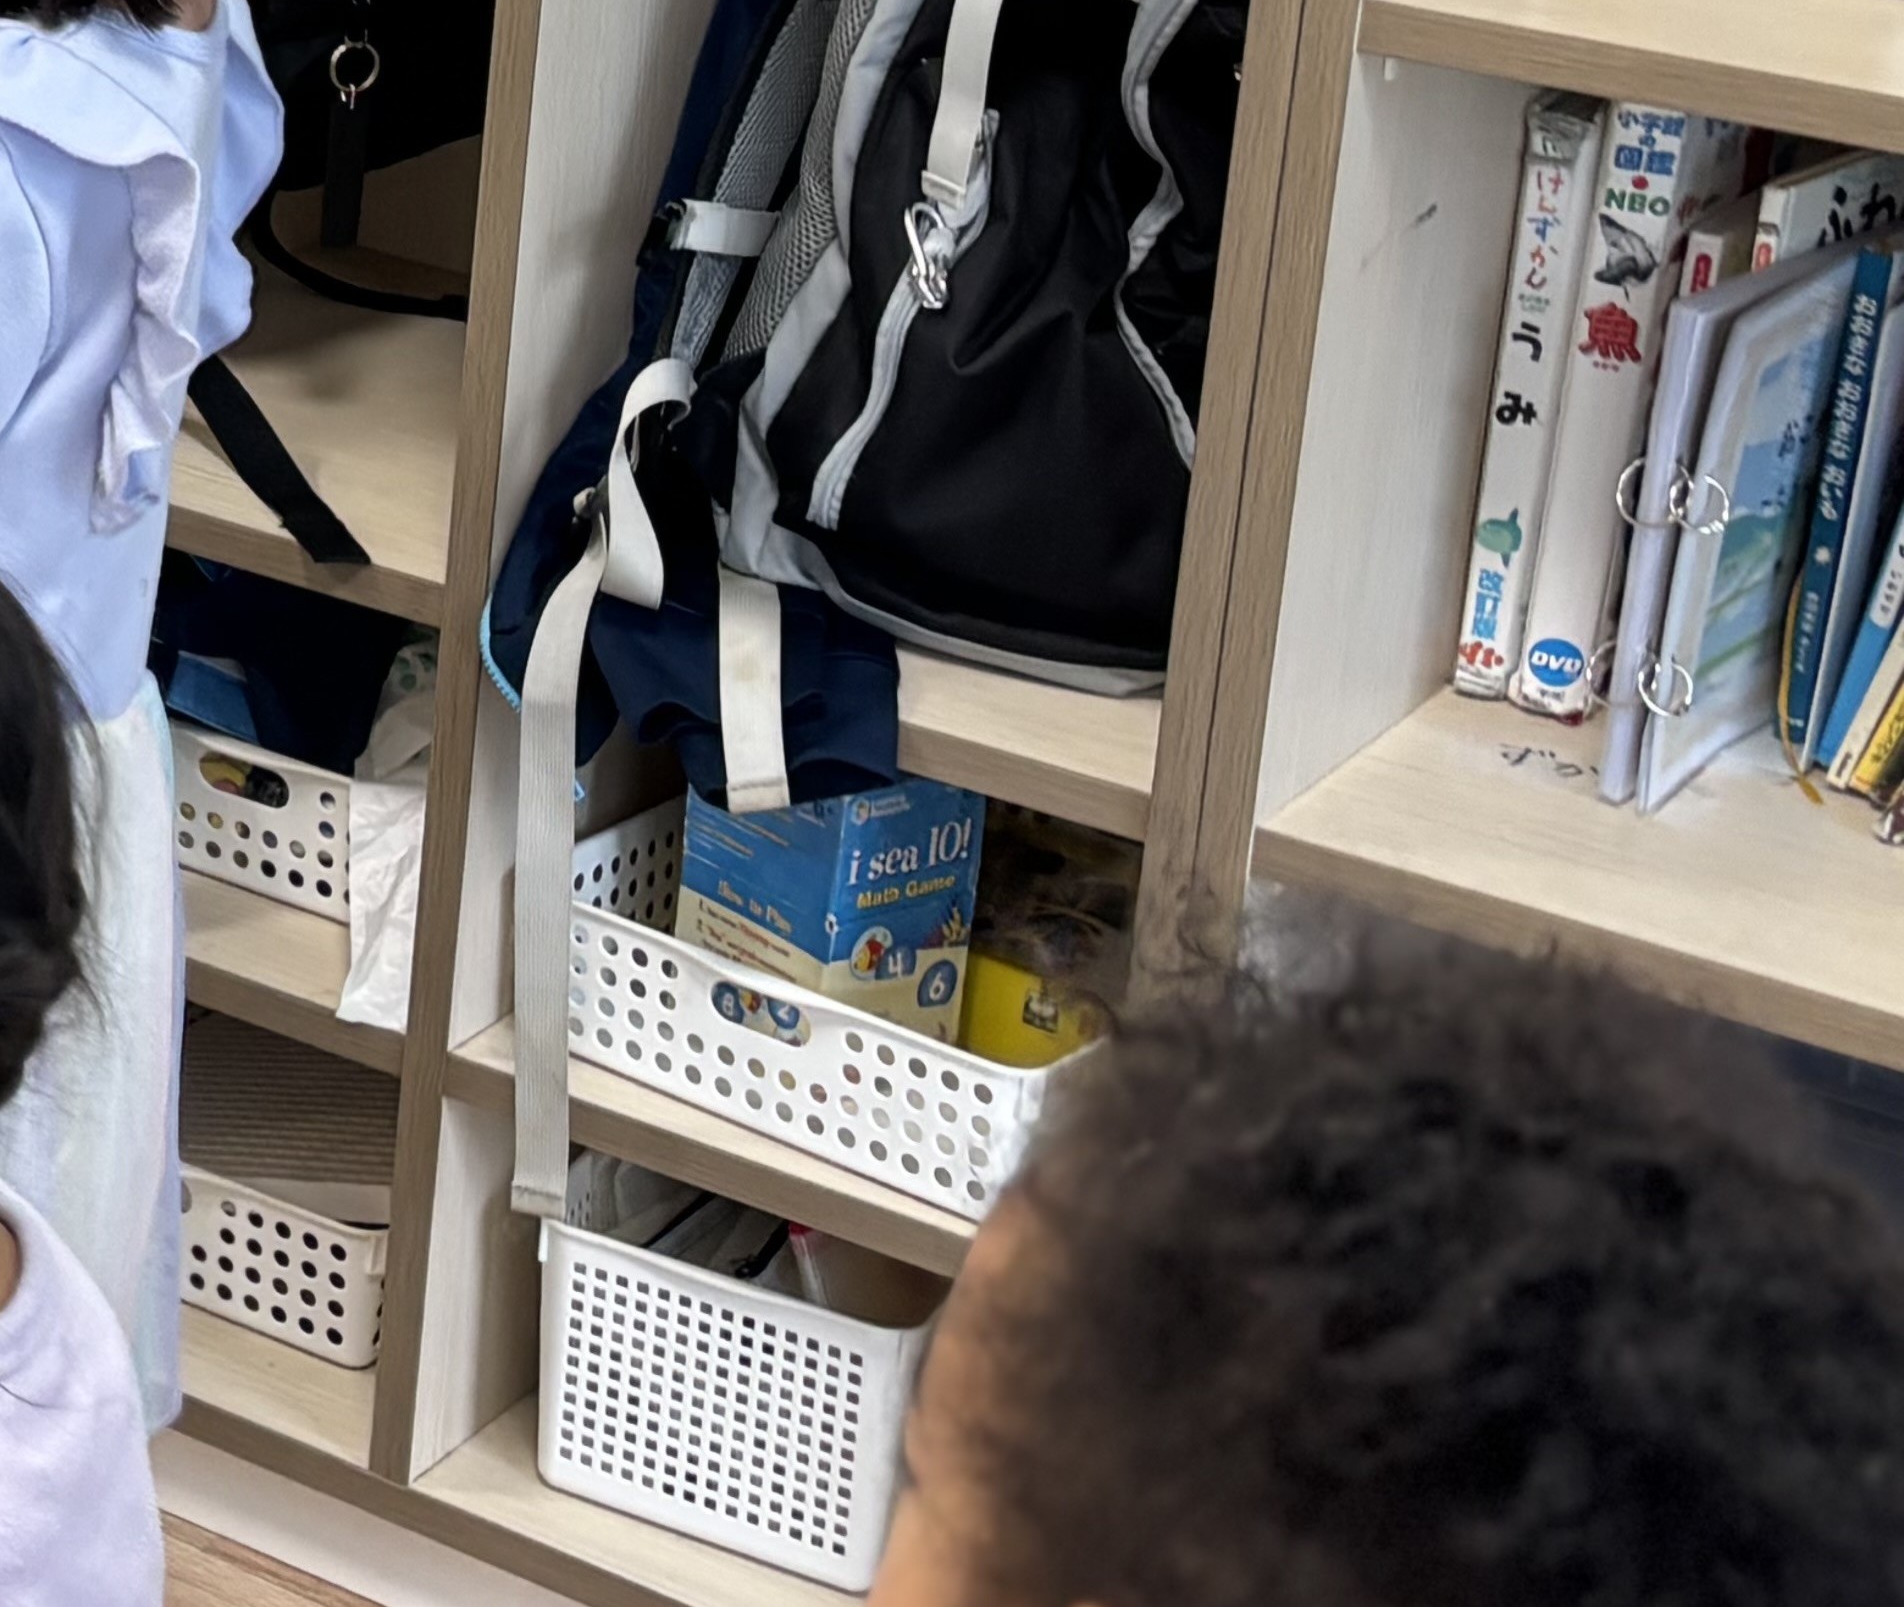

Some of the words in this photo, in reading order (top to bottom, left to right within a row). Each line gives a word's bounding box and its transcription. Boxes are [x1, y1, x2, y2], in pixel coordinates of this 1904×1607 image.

[1818, 181, 1904, 248] ふわ
[1578, 301, 1642, 364] 魚
[1495, 321, 1543, 426] うみ
[847, 850, 862, 885] i
[868, 845, 920, 880] sea
[857, 887, 900, 910] Math
[905, 876, 956, 898] Game
[929, 972, 946, 1000] 6
